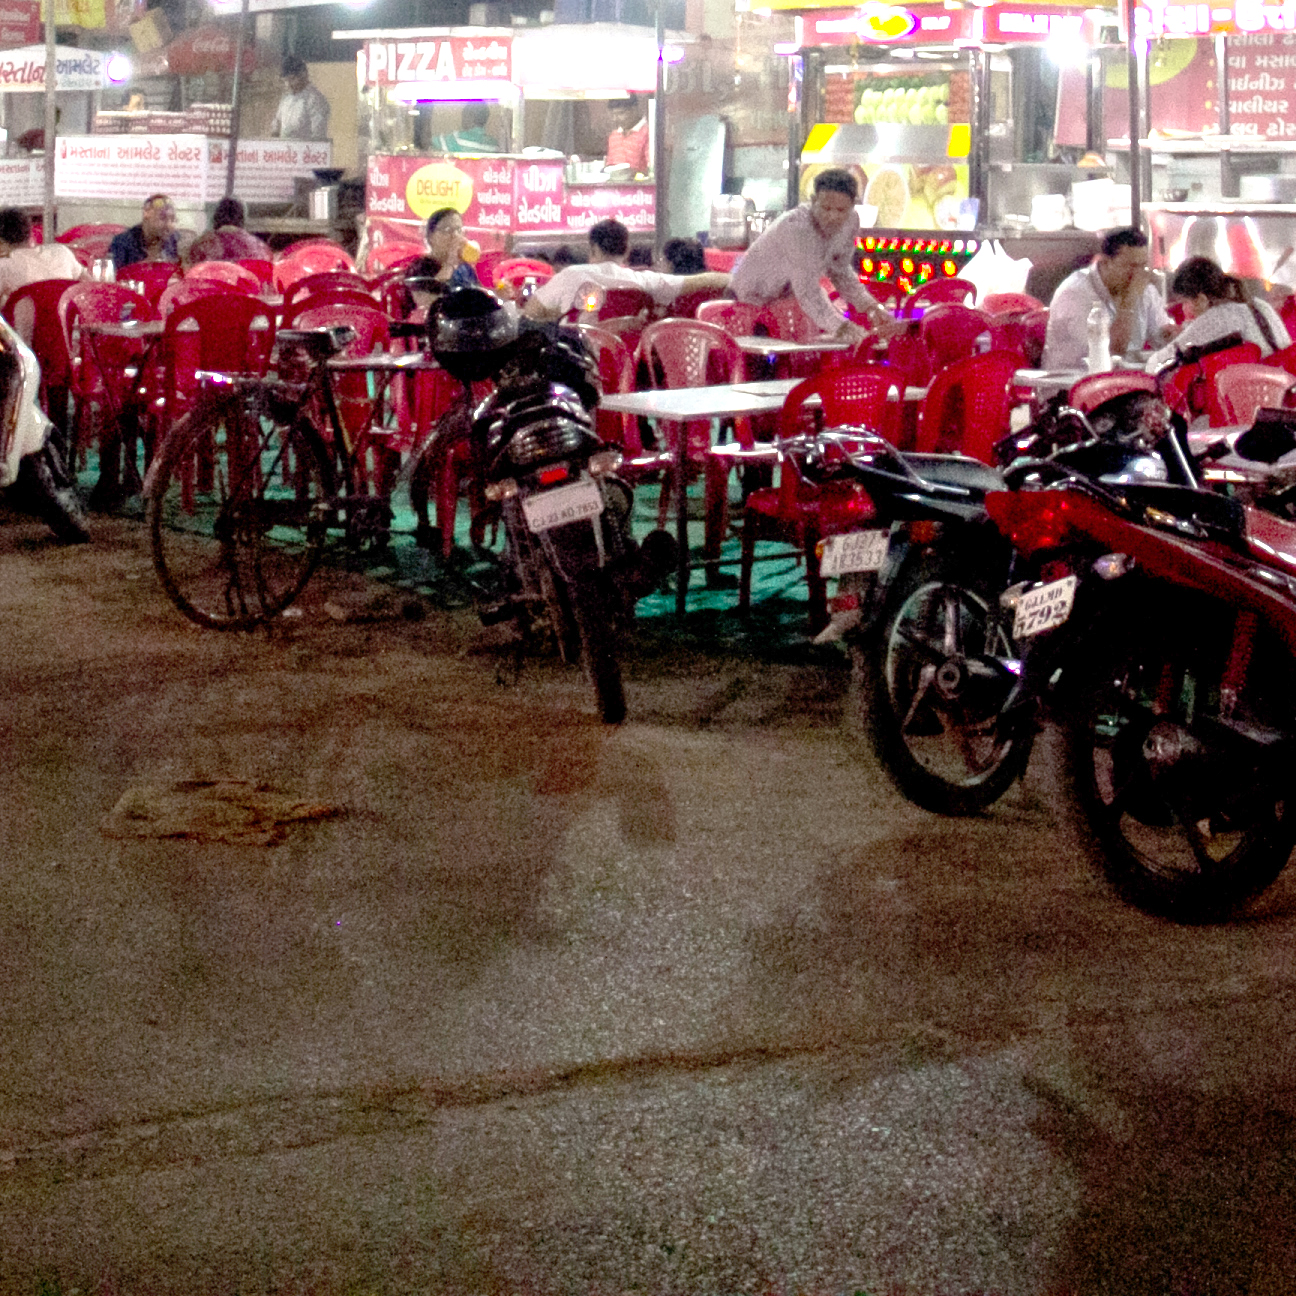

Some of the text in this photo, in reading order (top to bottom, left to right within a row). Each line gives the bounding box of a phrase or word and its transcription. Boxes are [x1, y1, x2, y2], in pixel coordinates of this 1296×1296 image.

[369, 41, 456, 82] PIZZA
[117, 141, 161, 161] આમલેટ
[168, 140, 201, 161] સેન્ટર
[416, 179, 462, 199] DELIGHT
[517, 197, 562, 224] સેન્ડવીચ
